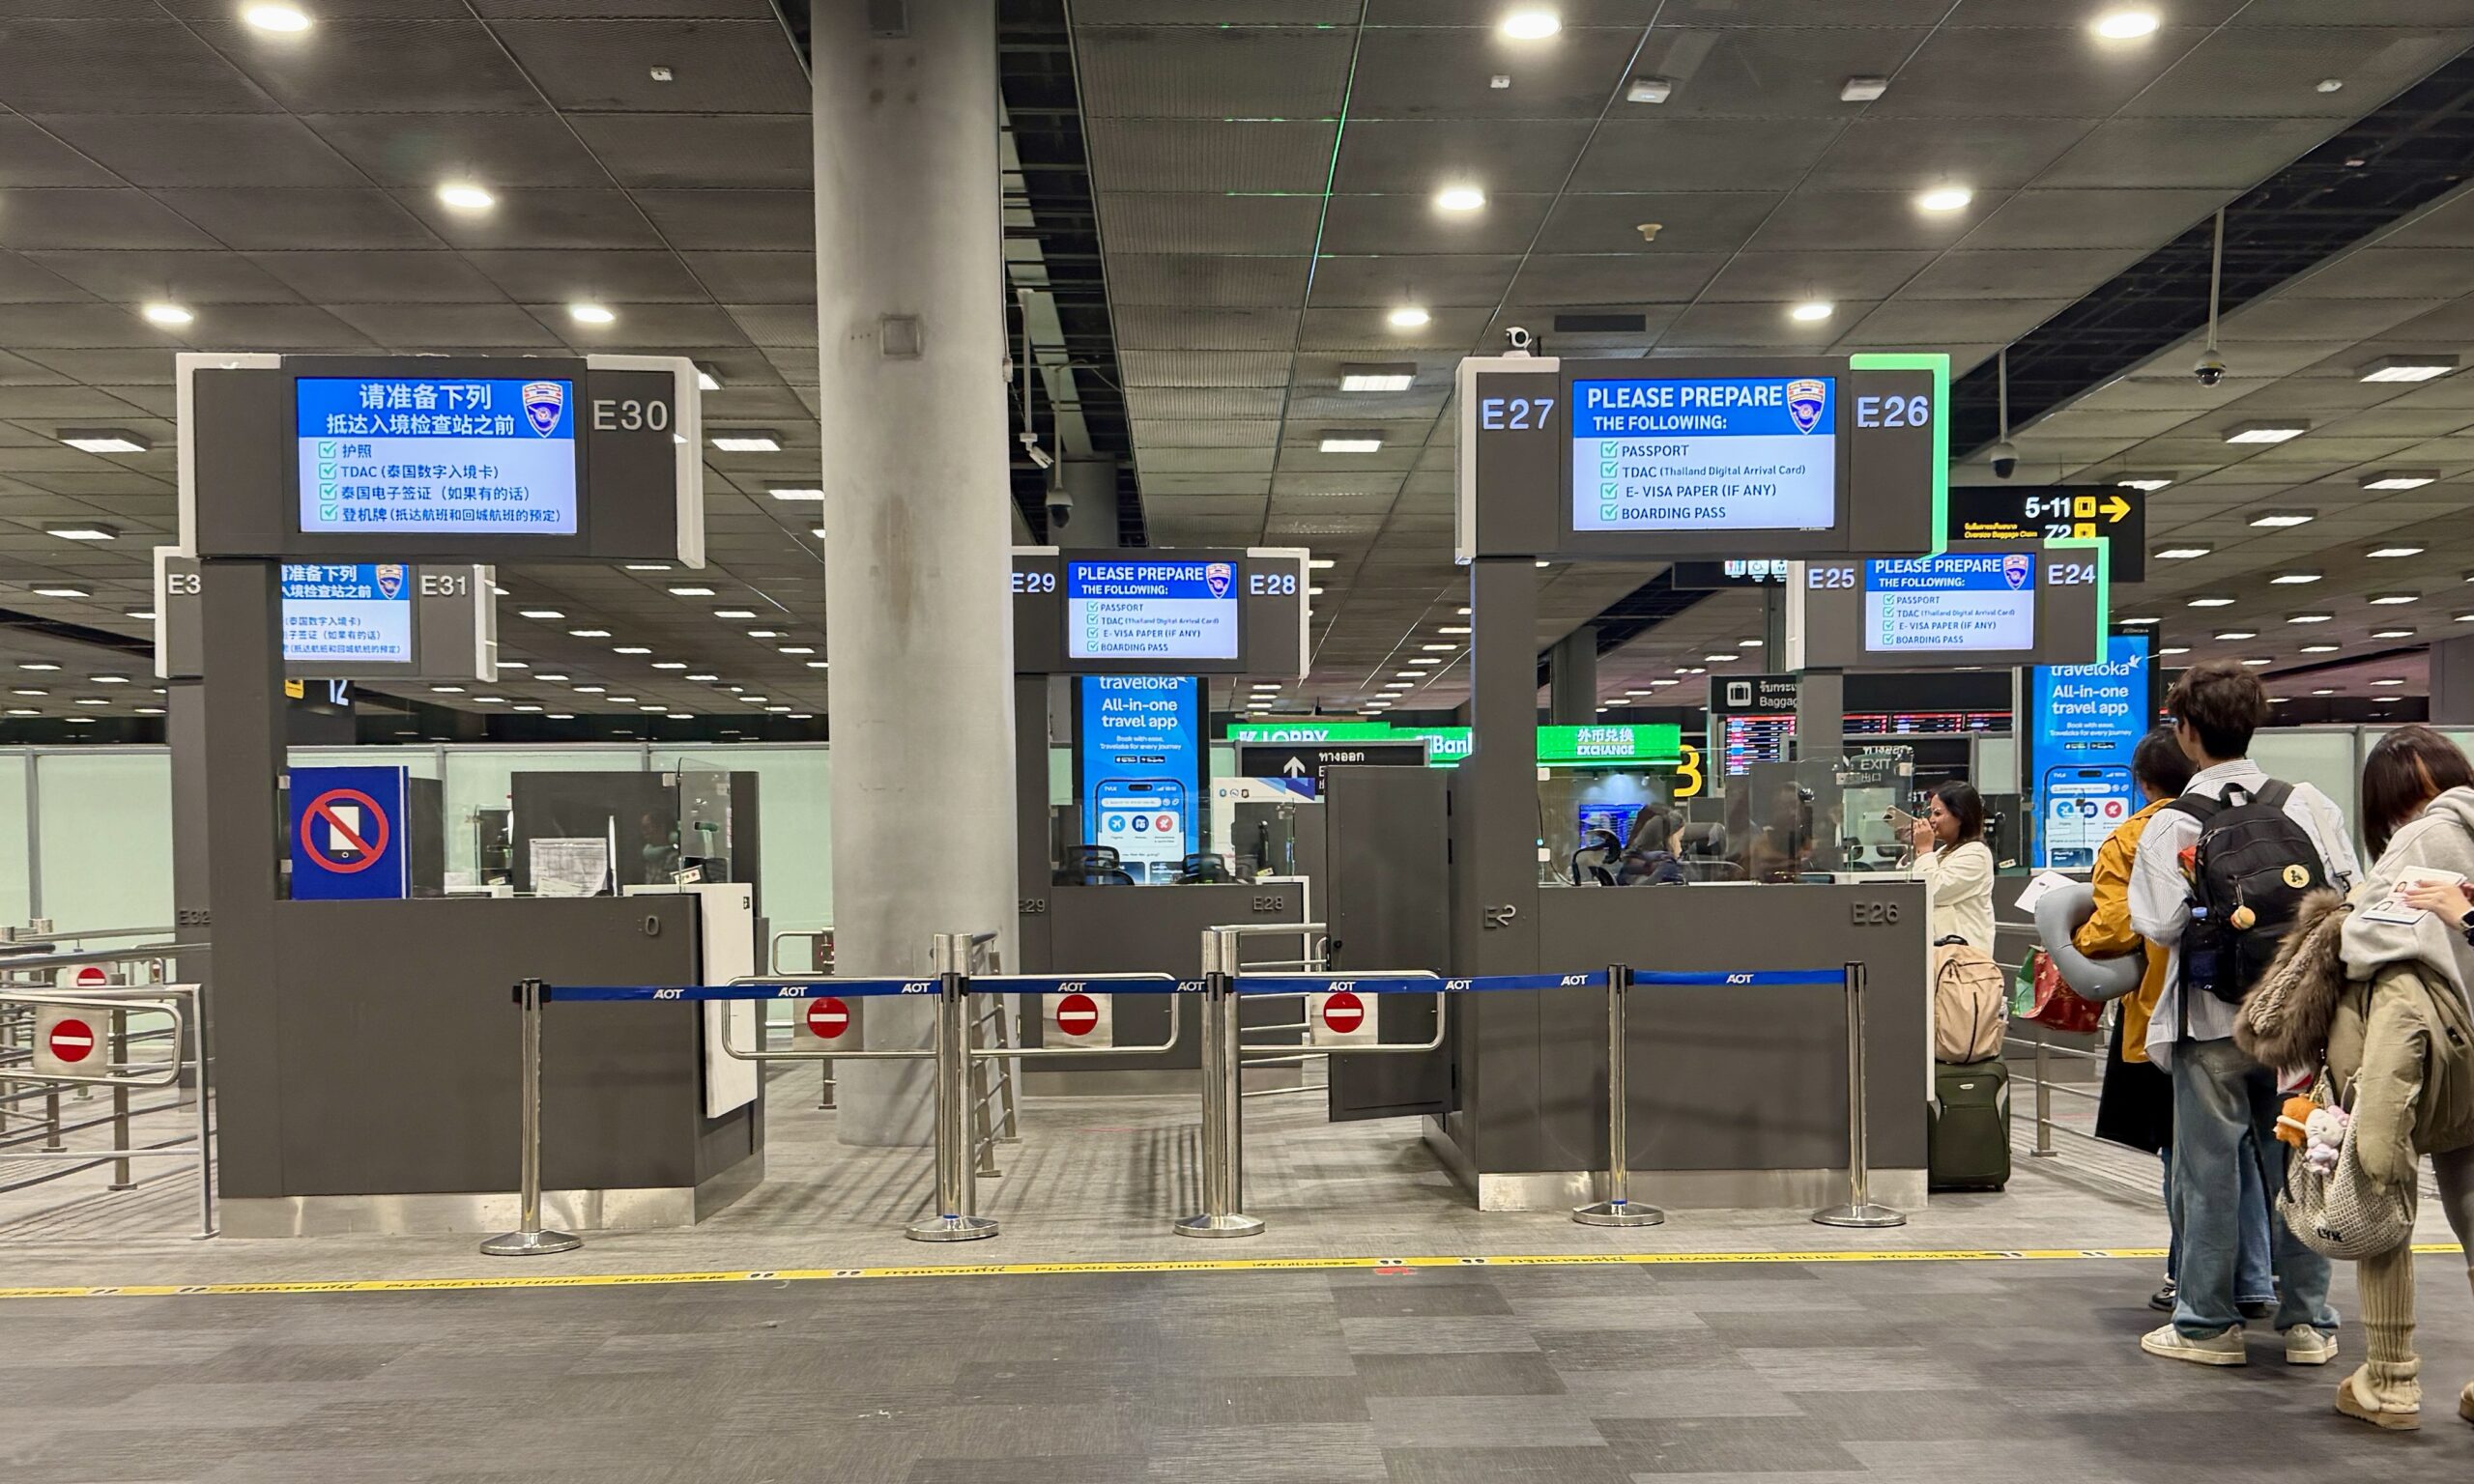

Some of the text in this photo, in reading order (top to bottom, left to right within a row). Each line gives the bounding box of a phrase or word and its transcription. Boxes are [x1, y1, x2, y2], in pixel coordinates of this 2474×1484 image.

[359, 383, 492, 411] 请准备下列
[1587, 385, 1784, 409] PLEASE PREPARE
[592, 399, 668, 431] E30
[1482, 398, 1555, 431] E27
[1856, 395, 1929, 428] E26
[326, 413, 515, 436] 抵达入境检查站之前
[1593, 414, 1728, 431] THE FOLLOWING:
[341, 443, 373, 459] 护照
[1622, 444, 1690, 458] PASSPORT
[341, 465, 378, 478] TDAC
[1623, 464, 1806, 478] TDAC (Thailand Digital Arrival Card)
[1625, 483, 1777, 499] E- VISA PAPER (IF ANY)
[1622, 505, 1727, 520] BOARDING PASS
[2025, 496, 2071, 519] 5-11
[1078, 566, 1205, 581] PLEASE PREPARE
[1875, 557, 2001, 575] PLEASE PREPARE
[1807, 567, 1856, 589] E25
[2047, 563, 2096, 586] E24
[168, 573, 202, 594] E3
[420, 575, 467, 596] E31
[1011, 572, 1056, 593] E29
[1250, 573, 1297, 596] E28
[1879, 577, 1966, 588] THE FOLLOWING:
[1081, 585, 1169, 596] THE FOLLOWING:
[1896, 595, 1941, 605] PASSPORT
[1100, 603, 1144, 613] PASSPORT
[1896, 609, 1920, 618] TDAC
[1101, 616, 1124, 625] TDAC
[1911, 621, 1930, 630] VISA
[1931, 621, 1960, 630] PAPER
[1960, 620, 1974, 631] (IF
[1975, 620, 1998, 630] ANY)
[1114, 629, 1135, 638] VISA
[1135, 629, 1164, 638] PAPER
[1165, 629, 1177, 639] (IF
[1178, 629, 1201, 638] ANY)
[1896, 635, 1964, 645] BOARDING PASS
[1101, 642, 1169, 652] BOARDING PASS
[2050, 659, 2131, 677] traveloka
[1100, 675, 1178, 690] traveloka
[2052, 683, 2129, 698] All-in-one
[1101, 698, 1178, 712] All-in-one
[1759, 696, 1798, 709] Baggag
[2052, 700, 2129, 717] travel app
[1101, 714, 1178, 730] travel app
[1577, 727, 1635, 743] 外币兑换
[1318, 752, 1365, 762] ทางออก
[1860, 758, 1891, 770] EXIT
[1673, 744, 1703, 798] 3
[1252, 896, 1284, 911] E28
[1852, 901, 1899, 924] E26
[1177, 981, 1206, 992] AOT
[1328, 981, 1356, 992] AOT
[1445, 979, 1473, 990] AOT
[1560, 974, 1588, 986] AOT
[1726, 973, 1754, 985] AOT
[653, 988, 684, 1001] AOT
[778, 985, 808, 998] AOT
[901, 982, 931, 994] AOT
[1057, 982, 1086, 992] AOT
